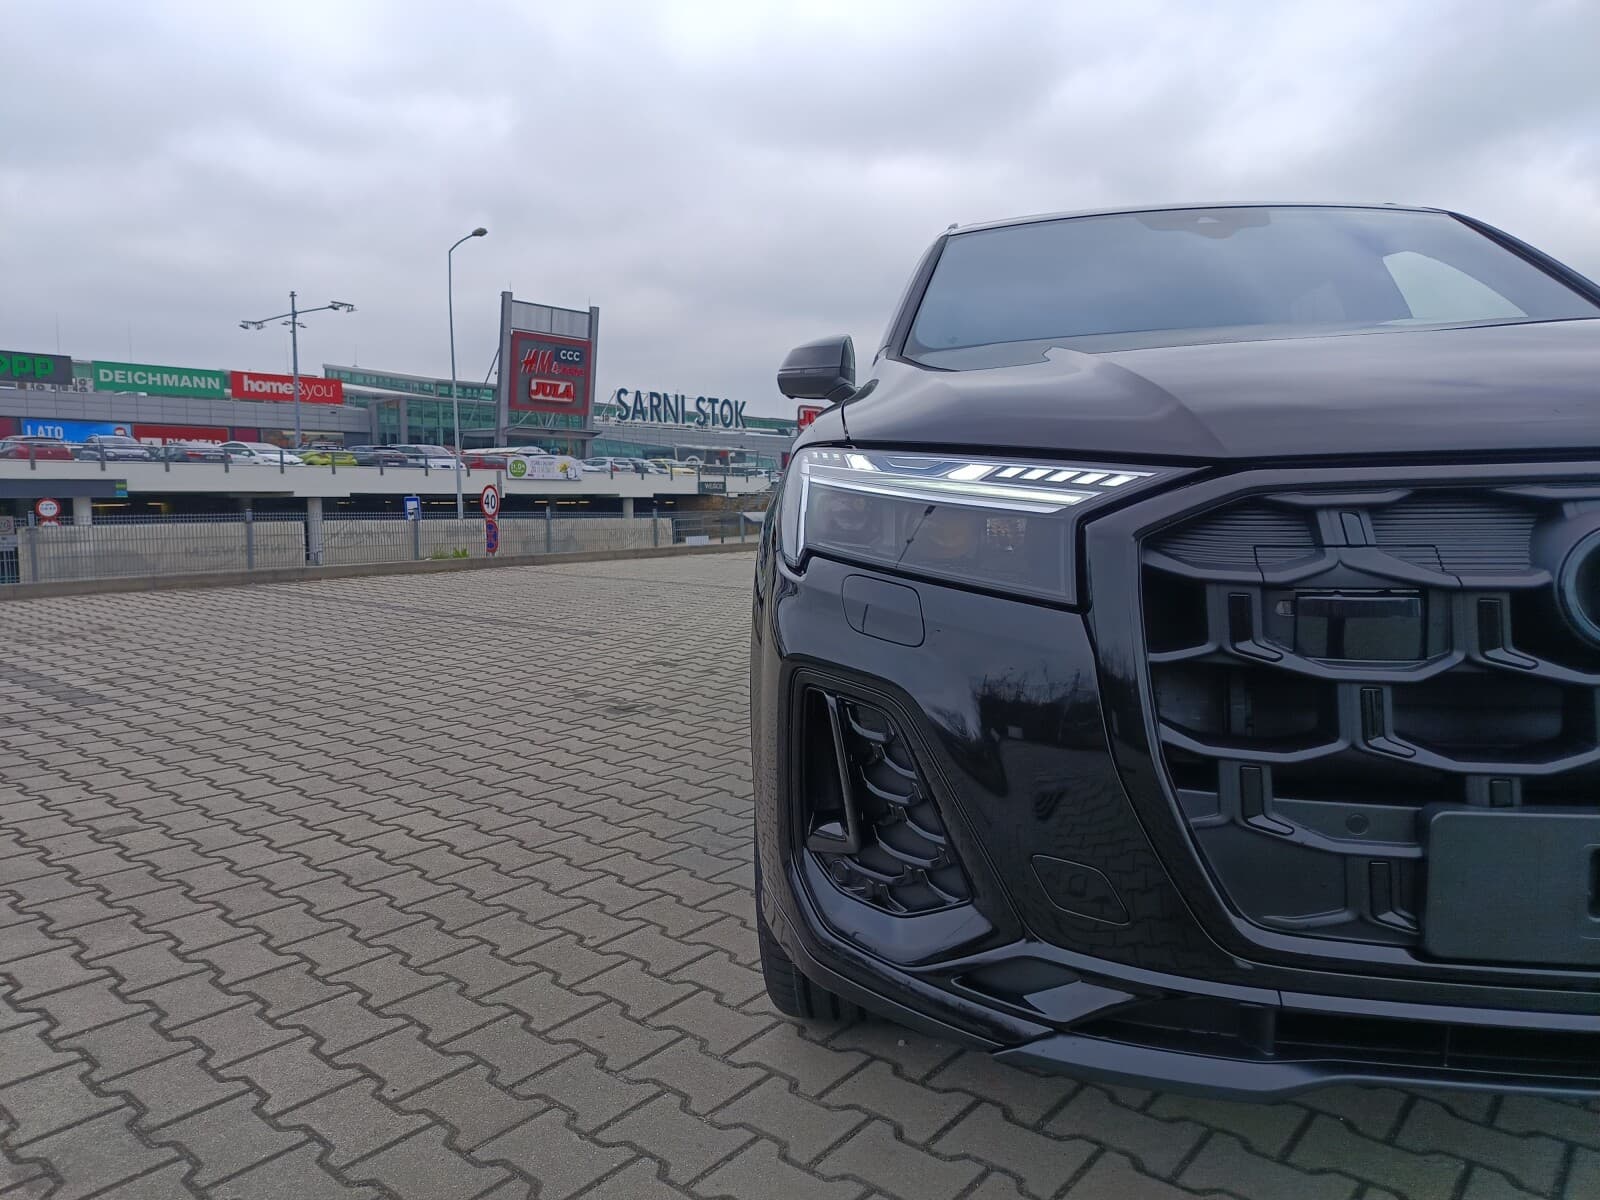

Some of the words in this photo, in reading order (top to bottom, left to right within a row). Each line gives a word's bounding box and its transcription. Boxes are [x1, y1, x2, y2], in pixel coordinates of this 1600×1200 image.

[560, 350, 580, 361] CCC
[98, 369, 221, 389] DEICHMANN
[531, 381, 574, 399] JULA
[616, 388, 686, 424] SARNI
[695, 396, 747, 429] STOK
[26, 425, 64, 439] LATO
[484, 494, 496, 510] 40
